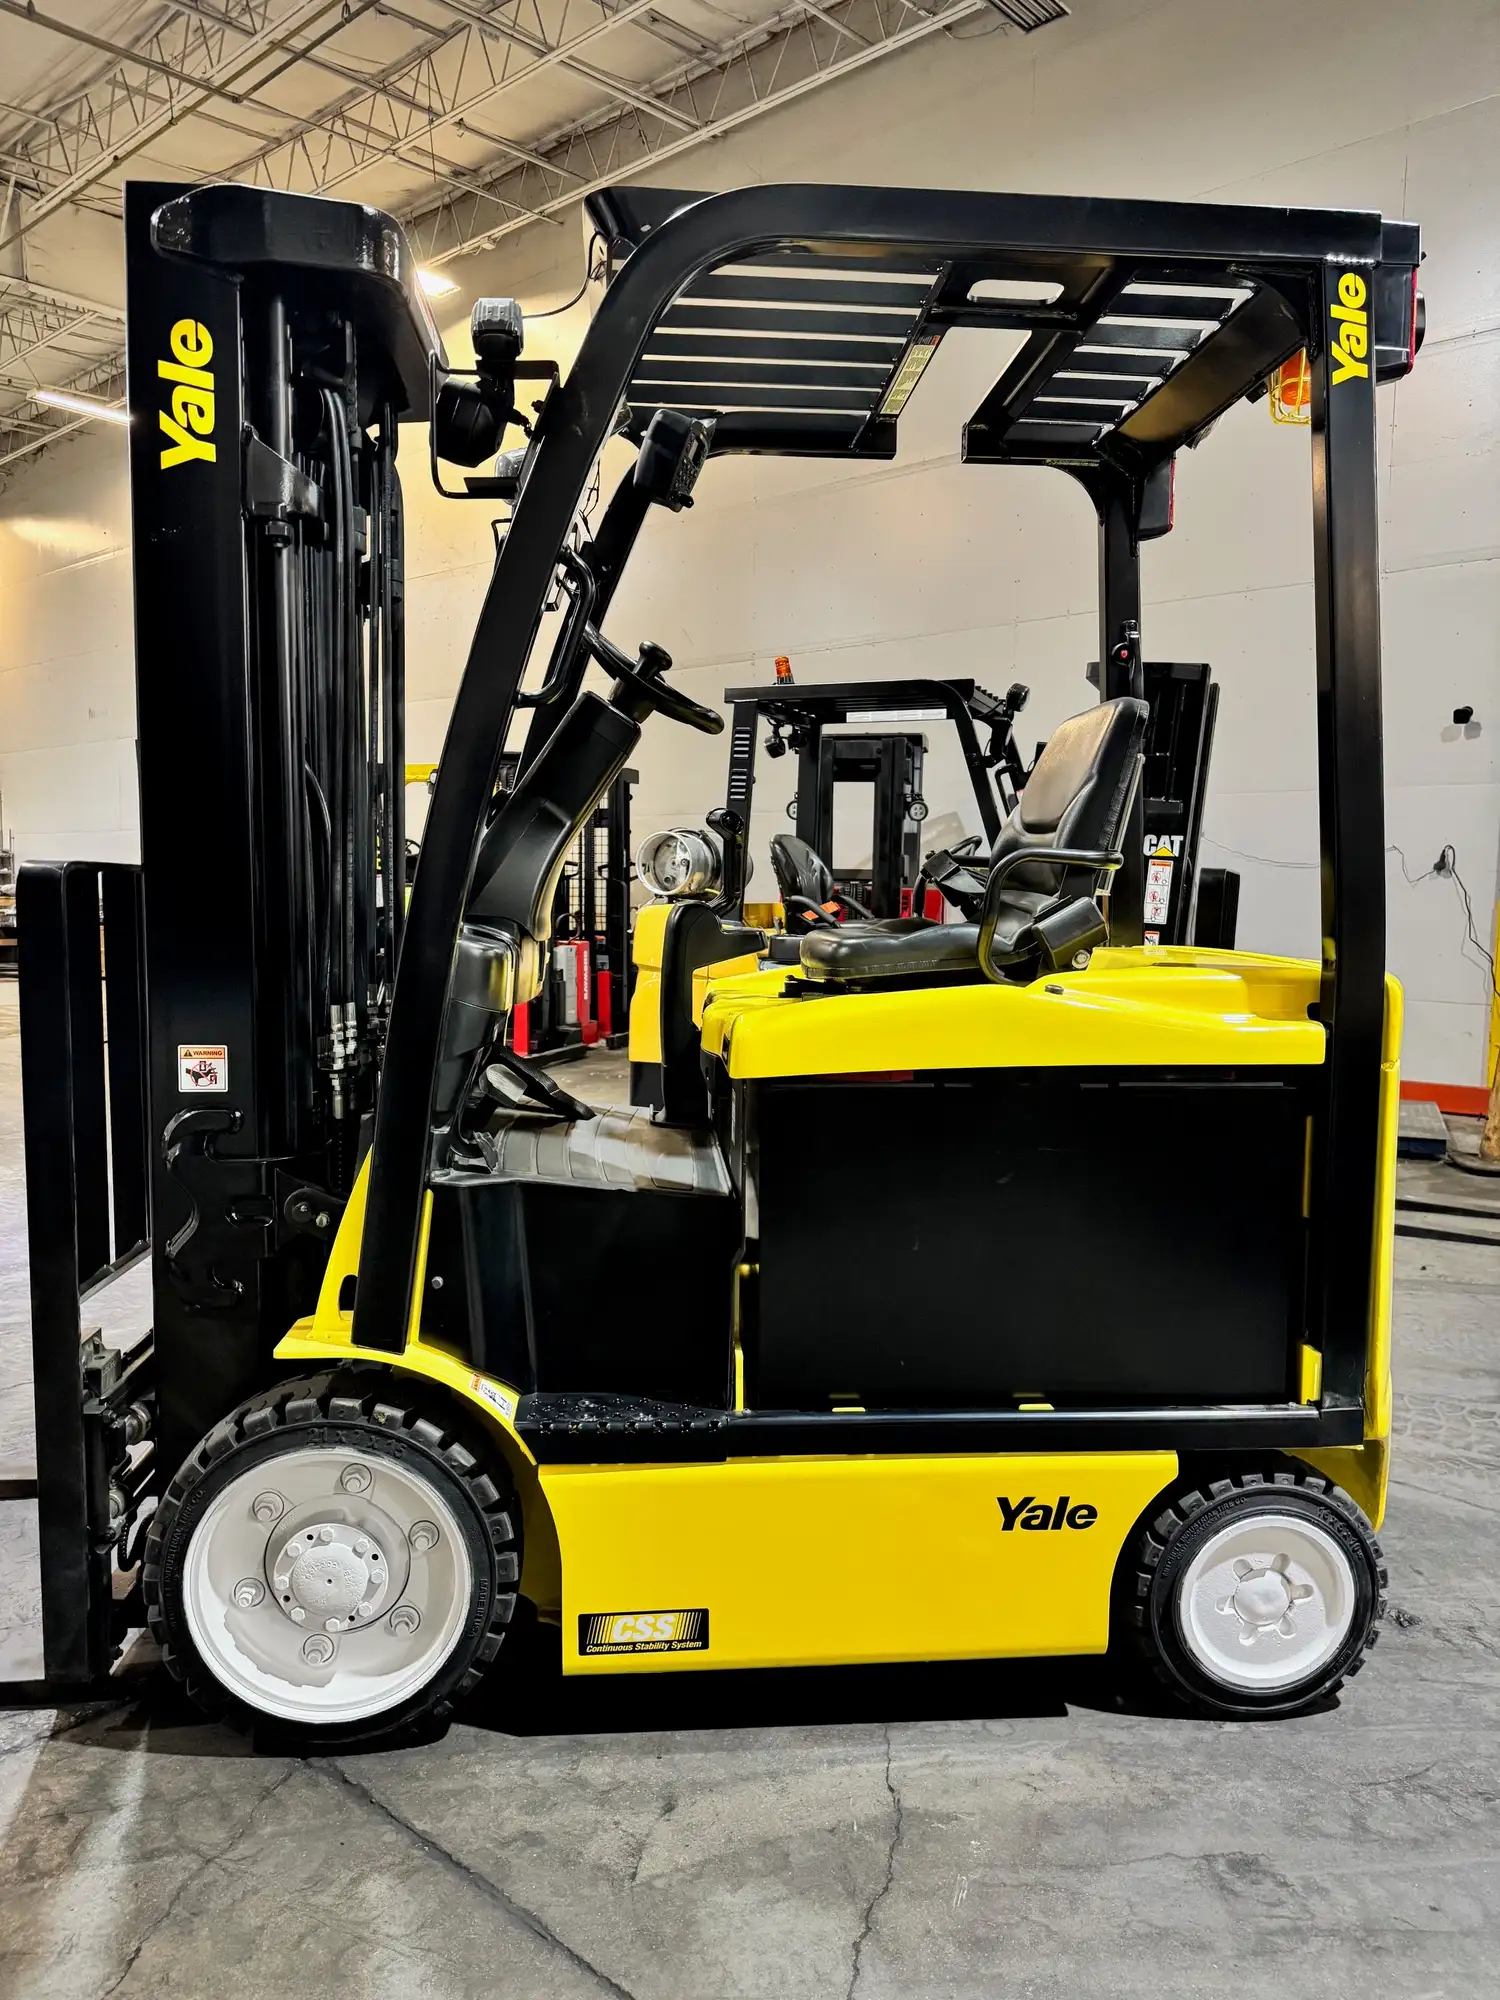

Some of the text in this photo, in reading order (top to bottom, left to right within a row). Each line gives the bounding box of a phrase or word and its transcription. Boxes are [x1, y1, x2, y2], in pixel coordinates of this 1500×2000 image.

[1331, 273, 1368, 385] Yale
[158, 319, 216, 469] Yale
[1143, 834, 1184, 857] CAT
[997, 1497, 1097, 1531] Yale
[612, 1614, 676, 1642] CSS
[586, 1640, 702, 1653] Continuous Stability System
